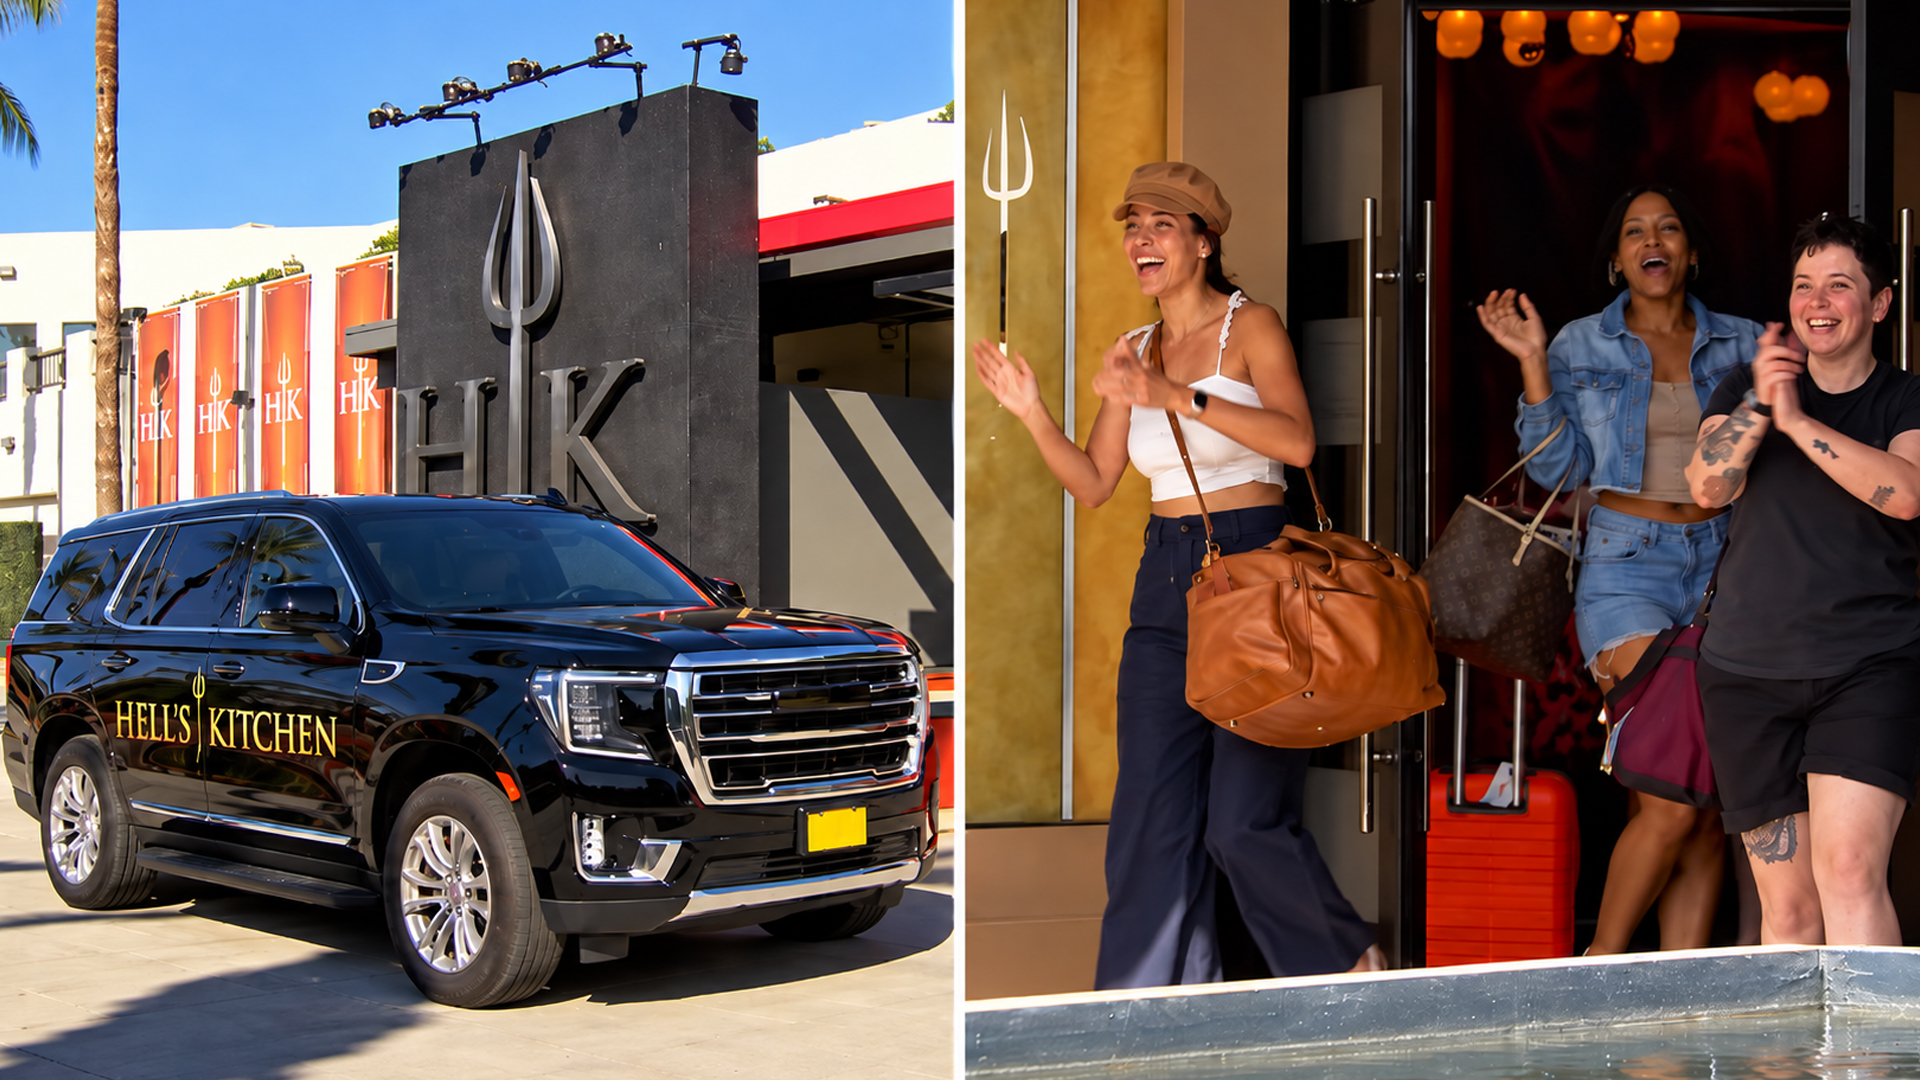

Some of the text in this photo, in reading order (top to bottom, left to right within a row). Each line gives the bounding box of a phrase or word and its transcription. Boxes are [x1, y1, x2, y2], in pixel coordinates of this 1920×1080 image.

[265, 387, 303, 424] HK
[339, 376, 381, 415] HK
[139, 408, 173, 442] HK
[198, 398, 232, 434] HK
[115, 700, 337, 758] HELL'S KITCHEN
